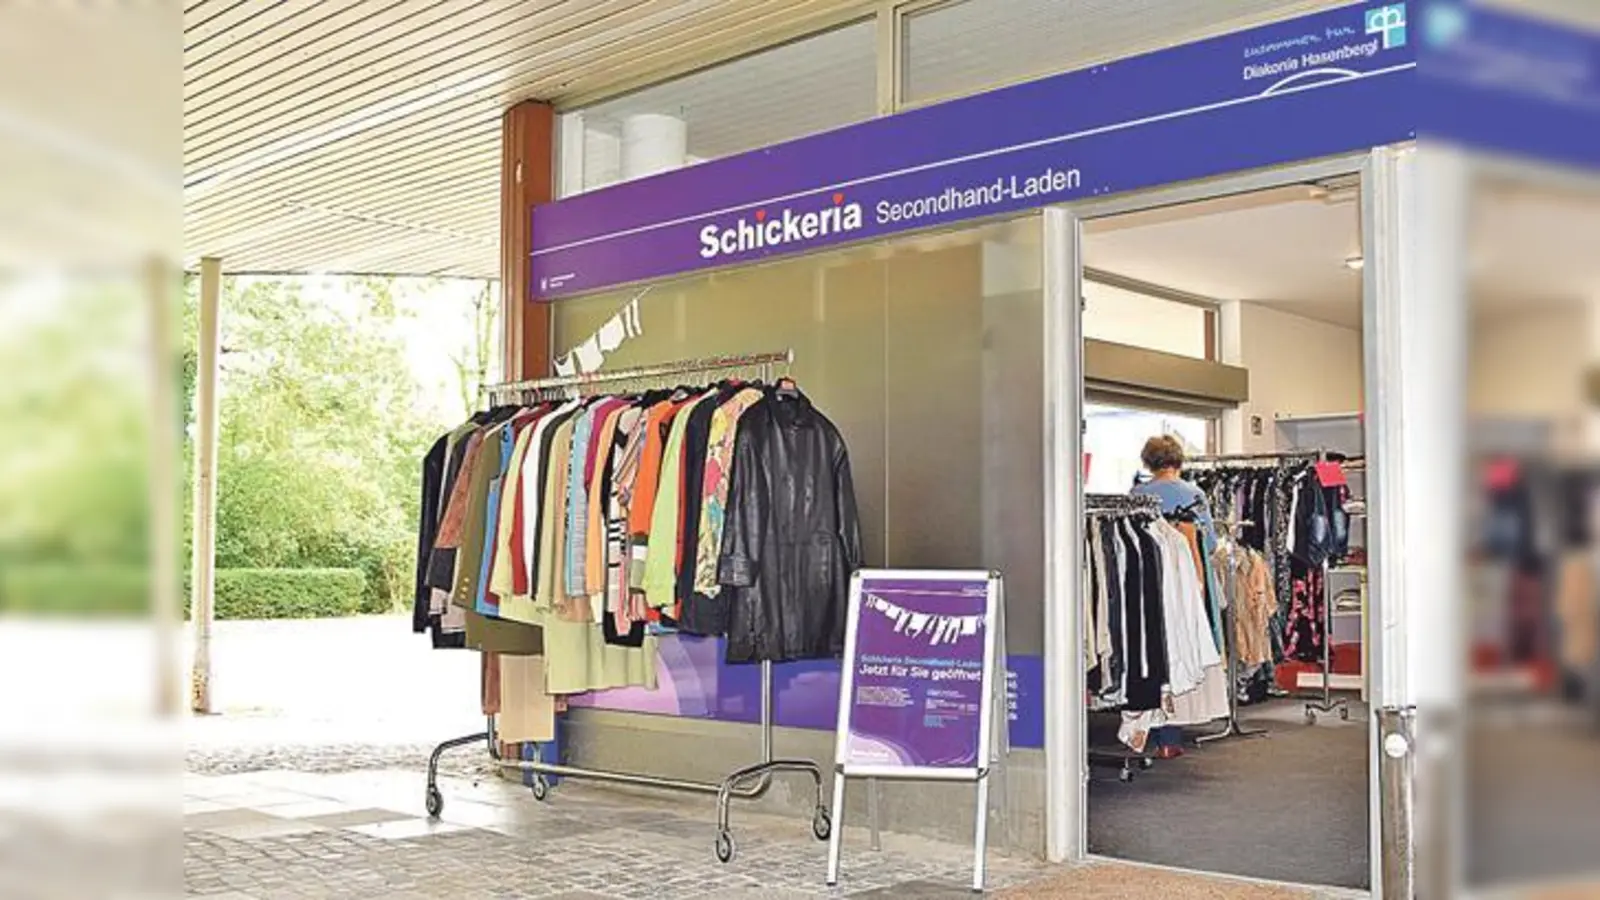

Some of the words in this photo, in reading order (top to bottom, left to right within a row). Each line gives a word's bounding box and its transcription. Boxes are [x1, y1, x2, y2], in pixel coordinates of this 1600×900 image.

[1243, 57, 1298, 80] Diakonie
[1303, 39, 1378, 67] Hasenbergl
[700, 193, 863, 258] Schickeria
[876, 167, 1081, 224] Secondhand-Laden
[859, 663, 889, 676] Jetzt
[891, 664, 908, 677] für
[910, 665, 930, 678] Sie
[931, 667, 981, 681] geöffnet
